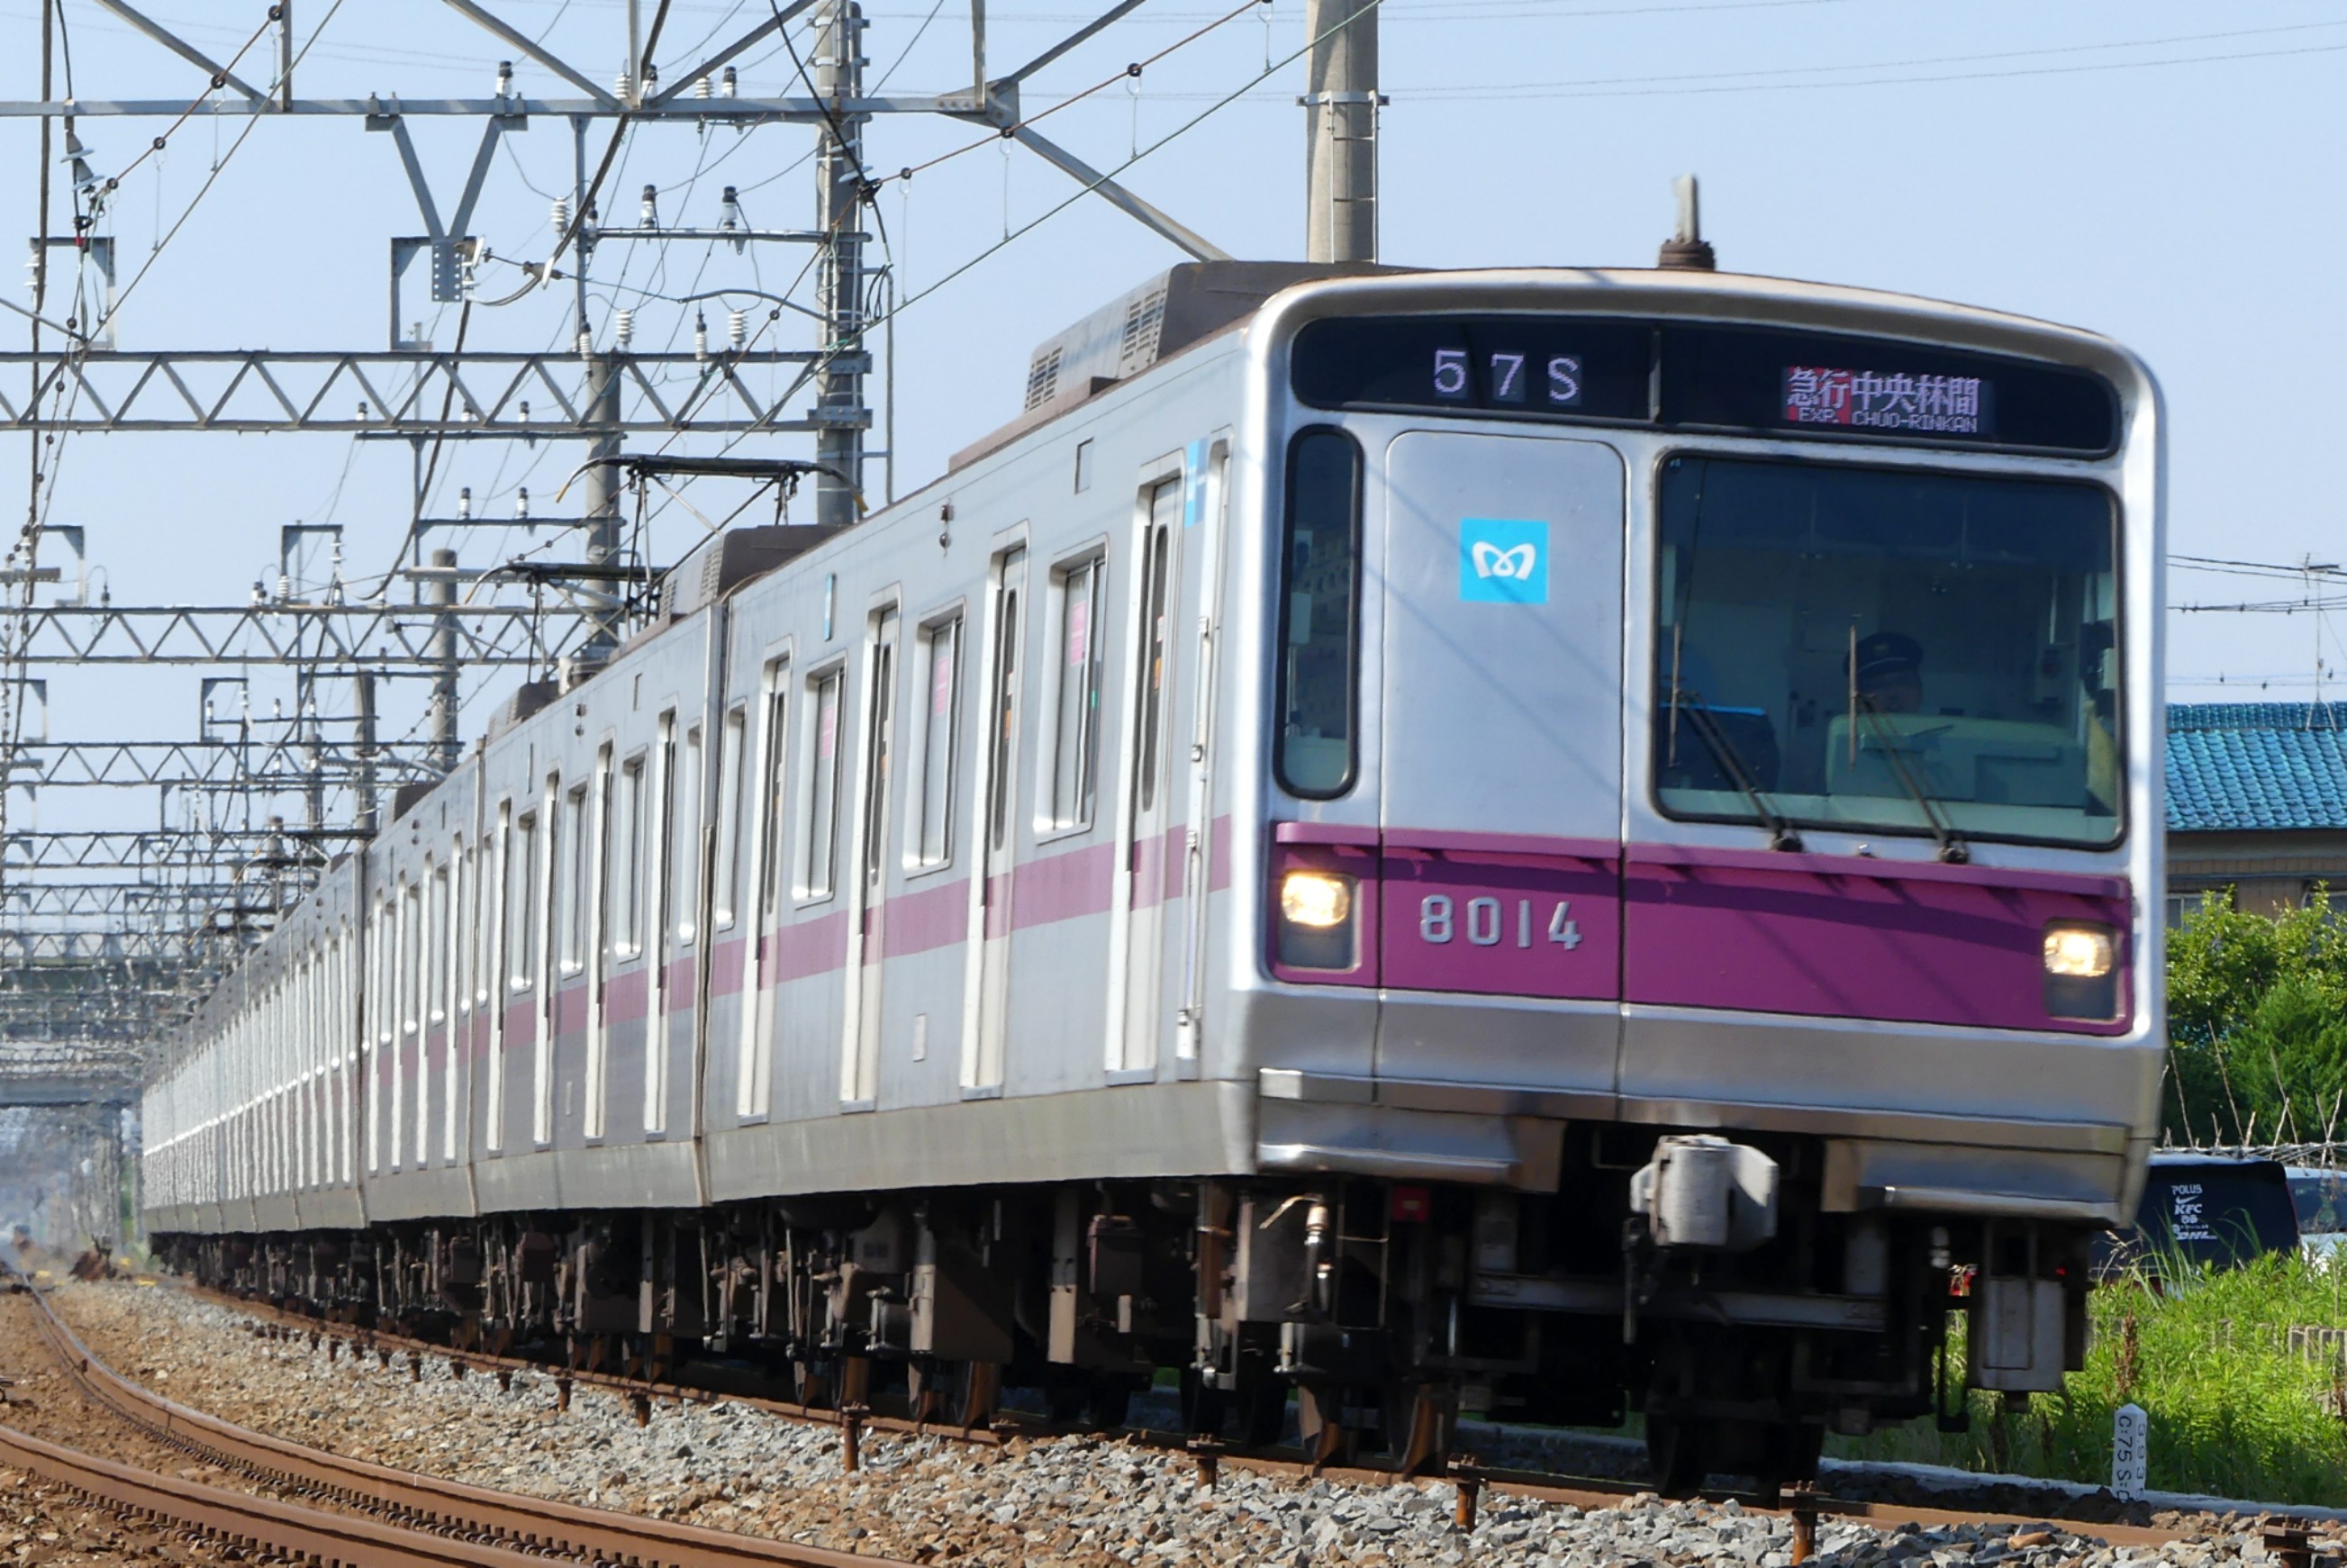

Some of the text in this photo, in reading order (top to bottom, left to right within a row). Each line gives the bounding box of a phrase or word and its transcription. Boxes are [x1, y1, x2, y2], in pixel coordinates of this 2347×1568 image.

[1787, 366, 1980, 416] 急行 中央林間
[1798, 407, 1977, 433] EXP. CHUO-RINKAN
[1420, 894, 1582, 950] 8014
[2170, 1183, 2203, 1195] POLUS
[2174, 1203, 2203, 1215] KFC
[2176, 1230, 2213, 1240] DHL
